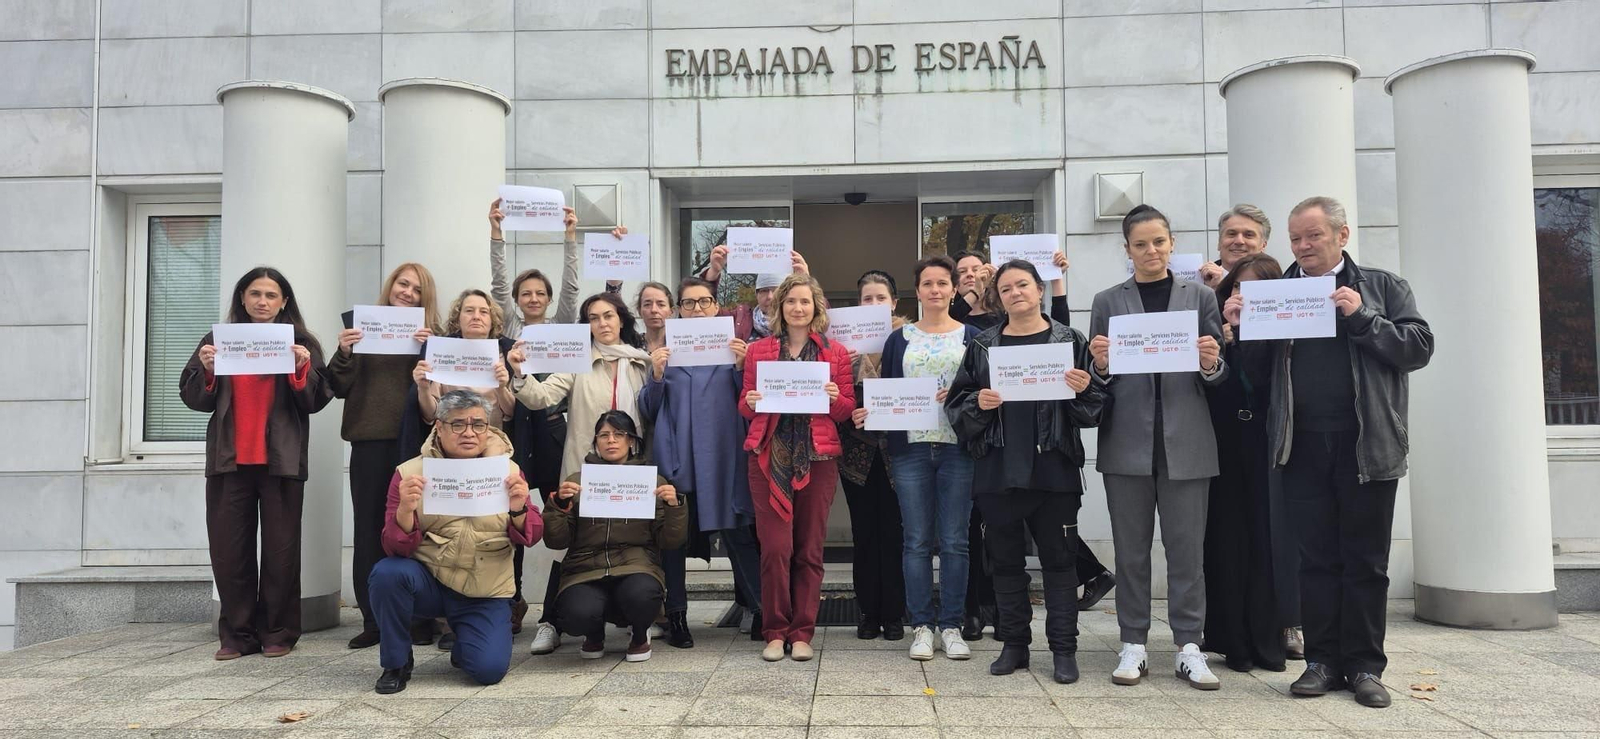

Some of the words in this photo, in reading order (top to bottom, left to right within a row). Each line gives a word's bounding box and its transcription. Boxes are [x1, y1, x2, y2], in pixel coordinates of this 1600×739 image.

[665, 45, 834, 78] EMBAJADA
[851, 43, 897, 74] DE
[914, 35, 1047, 72] ESPAÑA
[1284, 297, 1305, 305] Servicios
[1256, 305, 1278, 313] Empleo
[1296, 302, 1325, 311] calidad
[1123, 339, 1145, 347] Empleo
[1161, 337, 1189, 345] calidad
[1040, 368, 1065, 376] calidad
[438, 483, 460, 491] Empleo
[476, 481, 502, 490] calidad
